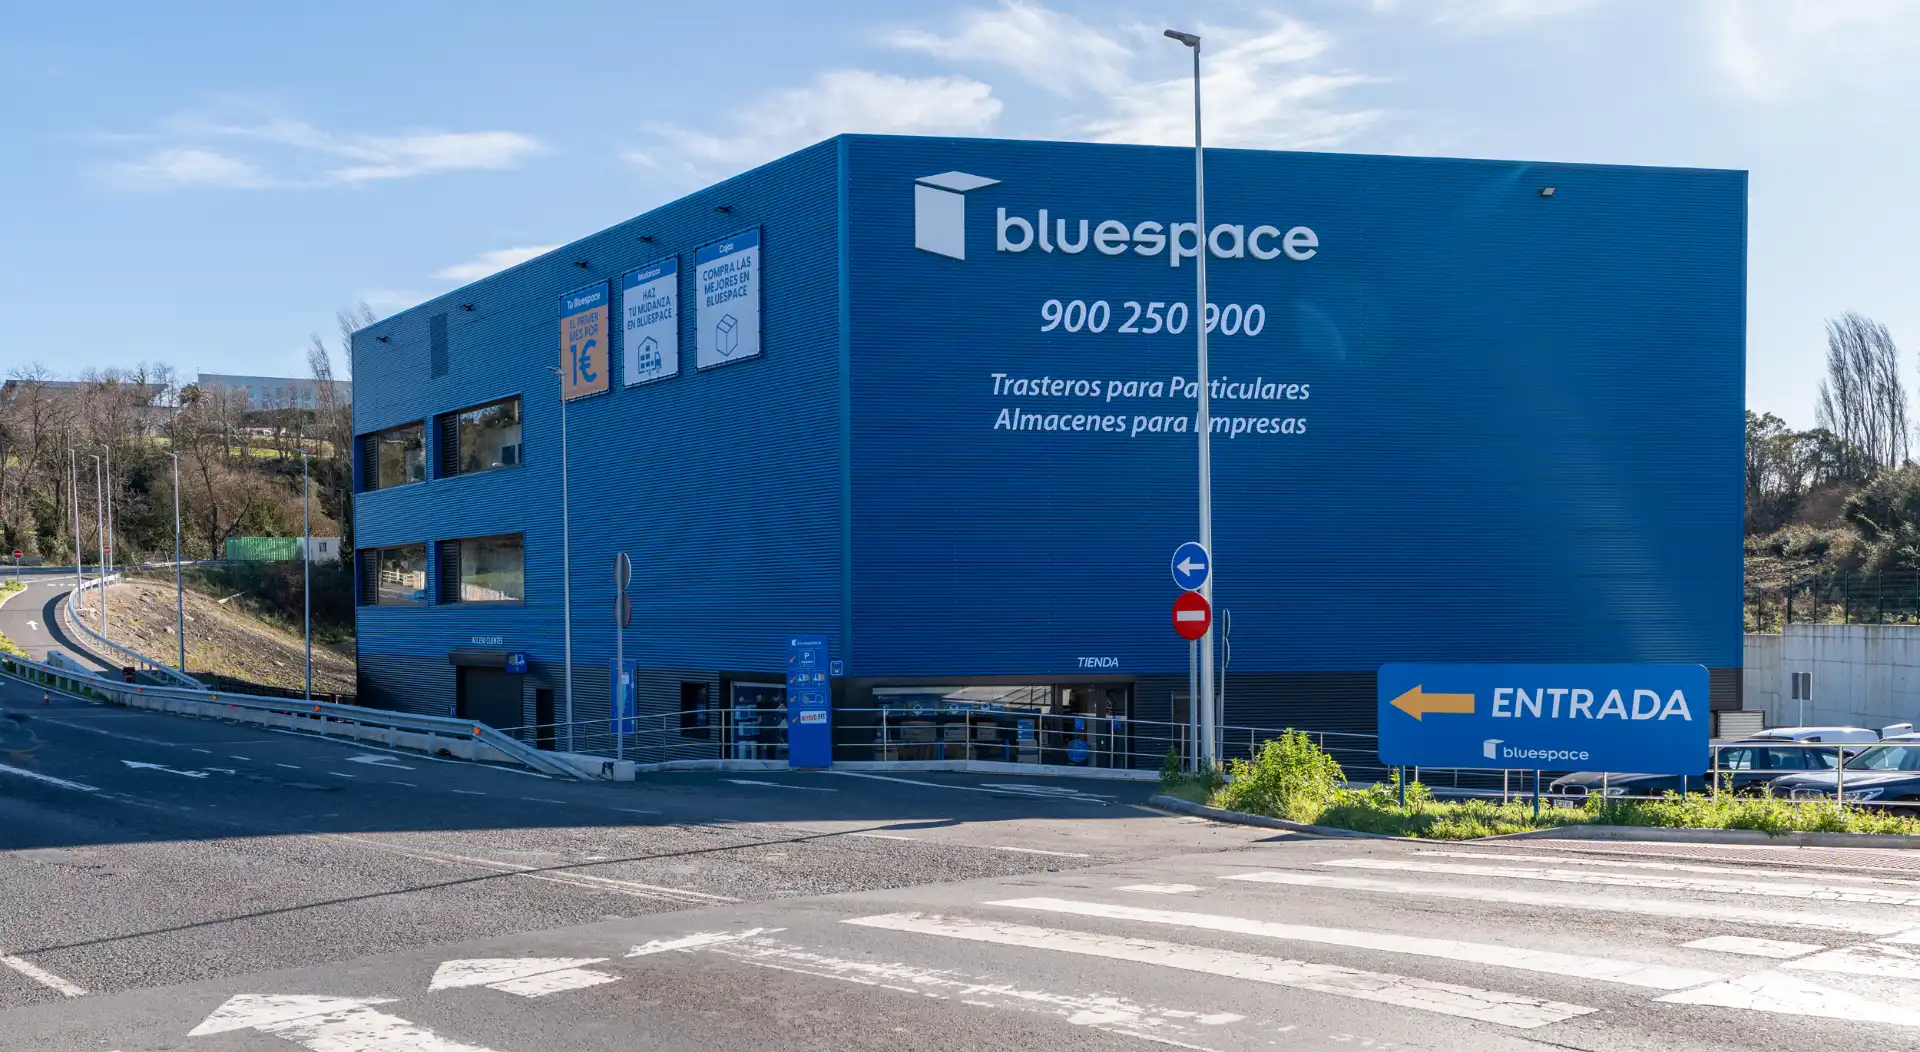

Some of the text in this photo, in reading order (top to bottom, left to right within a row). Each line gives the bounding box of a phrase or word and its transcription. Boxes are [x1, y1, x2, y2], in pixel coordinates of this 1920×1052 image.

[719, 243, 734, 253] Cajas
[998, 207, 1319, 268] bluespace
[703, 256, 751, 281] COMPRA LAS
[704, 271, 750, 295] MEJORES EN
[567, 292, 601, 310] Tu Bluespace
[642, 288, 656, 301] HAZ
[706, 285, 748, 307] BLUESPACE
[629, 296, 671, 317] TU MUDANZA
[1041, 299, 1266, 336] 900 250 900
[569, 311, 599, 330] EL PRIMER
[628, 308, 673, 330] EN BLUESPACE
[569, 323, 599, 344] MES POR
[570, 338, 597, 387] 1€
[991, 373, 1310, 402] Trasteros para Paticulares
[994, 408, 1126, 432] Almacenes
[1131, 415, 1188, 437] para
[804, 652, 810, 660] P
[1077, 656, 1119, 668] TIENDA
[1491, 687, 1693, 721] ENTRADA
[1503, 746, 1590, 762] bluespace
